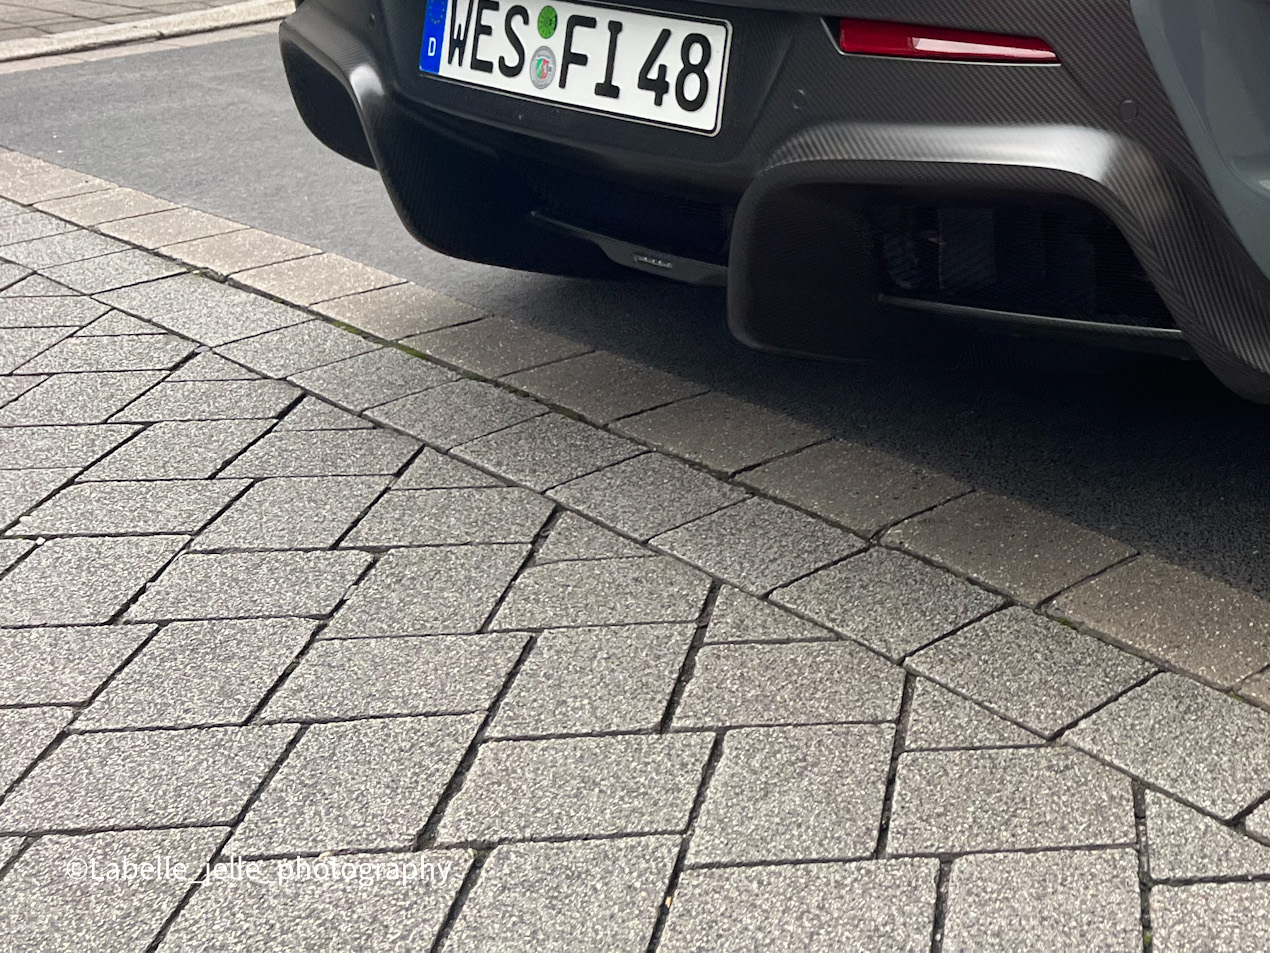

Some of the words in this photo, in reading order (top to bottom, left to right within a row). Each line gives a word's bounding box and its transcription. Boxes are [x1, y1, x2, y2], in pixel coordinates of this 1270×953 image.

[427, 36, 437, 57] D
[558, 14, 623, 99] FI
[637, 28, 712, 112] 48
